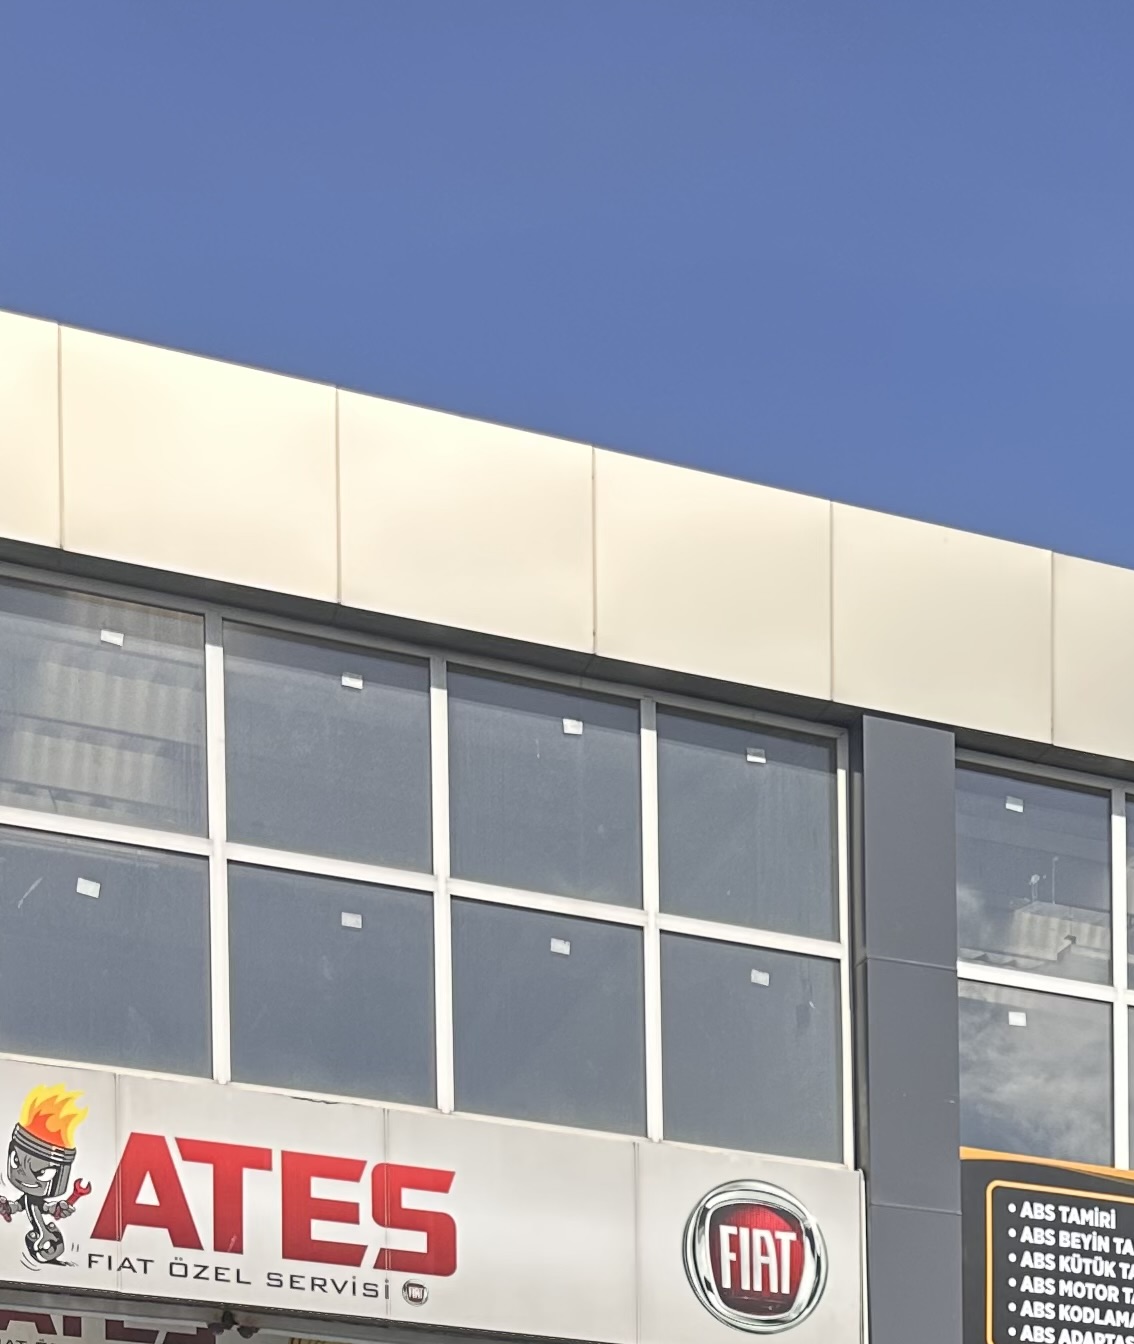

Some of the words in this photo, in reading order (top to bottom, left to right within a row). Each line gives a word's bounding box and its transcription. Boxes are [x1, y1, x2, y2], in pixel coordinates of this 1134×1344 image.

[90, 1132, 457, 1277] ATES
[1020, 1201, 1055, 1221] ABS
[1058, 1206, 1116, 1229] TAMİRİ
[1020, 1226, 1055, 1246] ABS
[1058, 1230, 1110, 1253] BEYİN
[719, 1224, 797, 1294] FIAT
[1020, 1250, 1055, 1271] ABS
[1058, 1253, 1117, 1278] KÜTÜK
[88, 1253, 155, 1275] FIAT
[168, 1257, 252, 1285] ÖZEL
[266, 1273, 391, 1299] SERVİSİ
[1020, 1275, 1055, 1296] ABS
[1058, 1279, 1119, 1303] MOTOR
[1020, 1300, 1055, 1320] ABS
[1020, 1324, 1055, 1344] ABS
